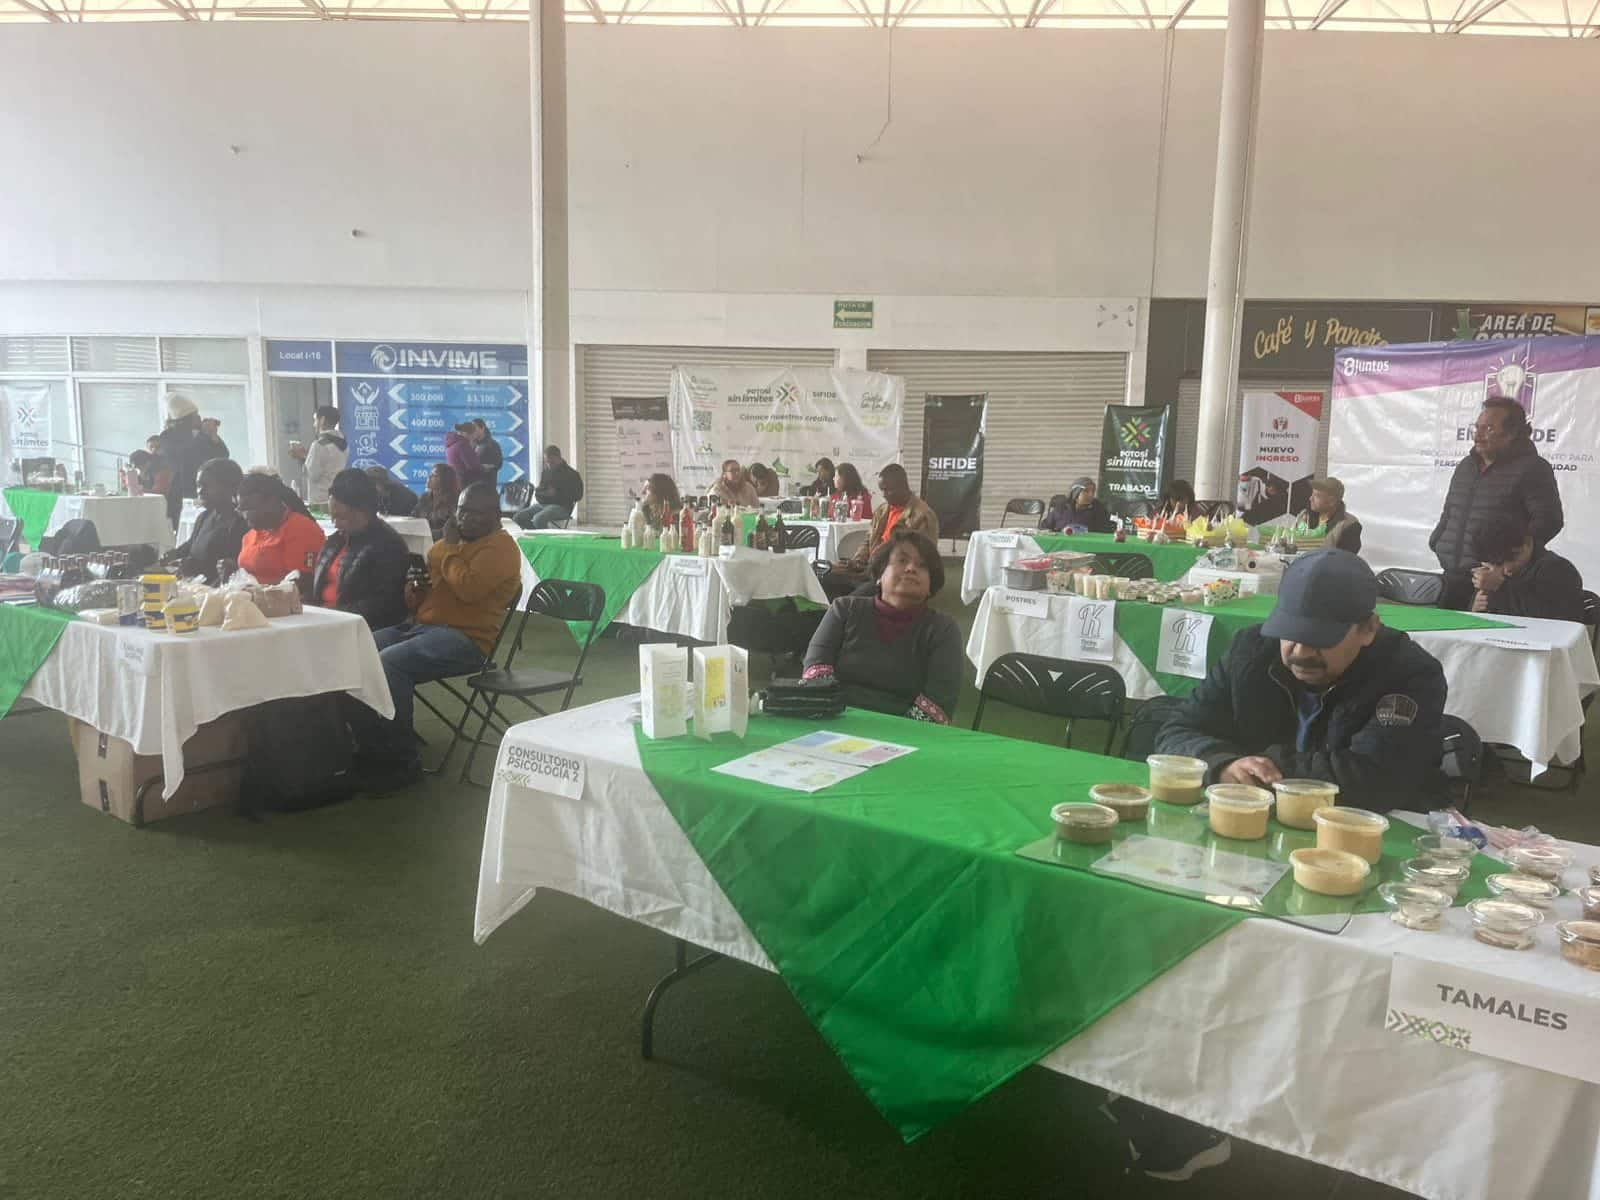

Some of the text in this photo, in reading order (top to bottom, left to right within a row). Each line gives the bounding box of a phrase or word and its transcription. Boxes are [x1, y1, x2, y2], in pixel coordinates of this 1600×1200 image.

[1531, 315, 1555, 332] DE
[1253, 316, 1292, 359] Café
[1304, 319, 1317, 348] y
[279, 351, 304, 360] Local
[398, 349, 498, 369] INVIME
[1259, 446, 1295, 454] NUEVO
[928, 456, 977, 470] SIFIDE
[1255, 455, 1300, 463] INGRESO
[1109, 482, 1151, 493] TRABAJO
[1005, 594, 1037, 606] POSTRES
[508, 745, 581, 771] CONSULTORIO
[507, 756, 579, 783] PSICOLOGIA 2
[1436, 983, 1569, 1031] TAMALES
